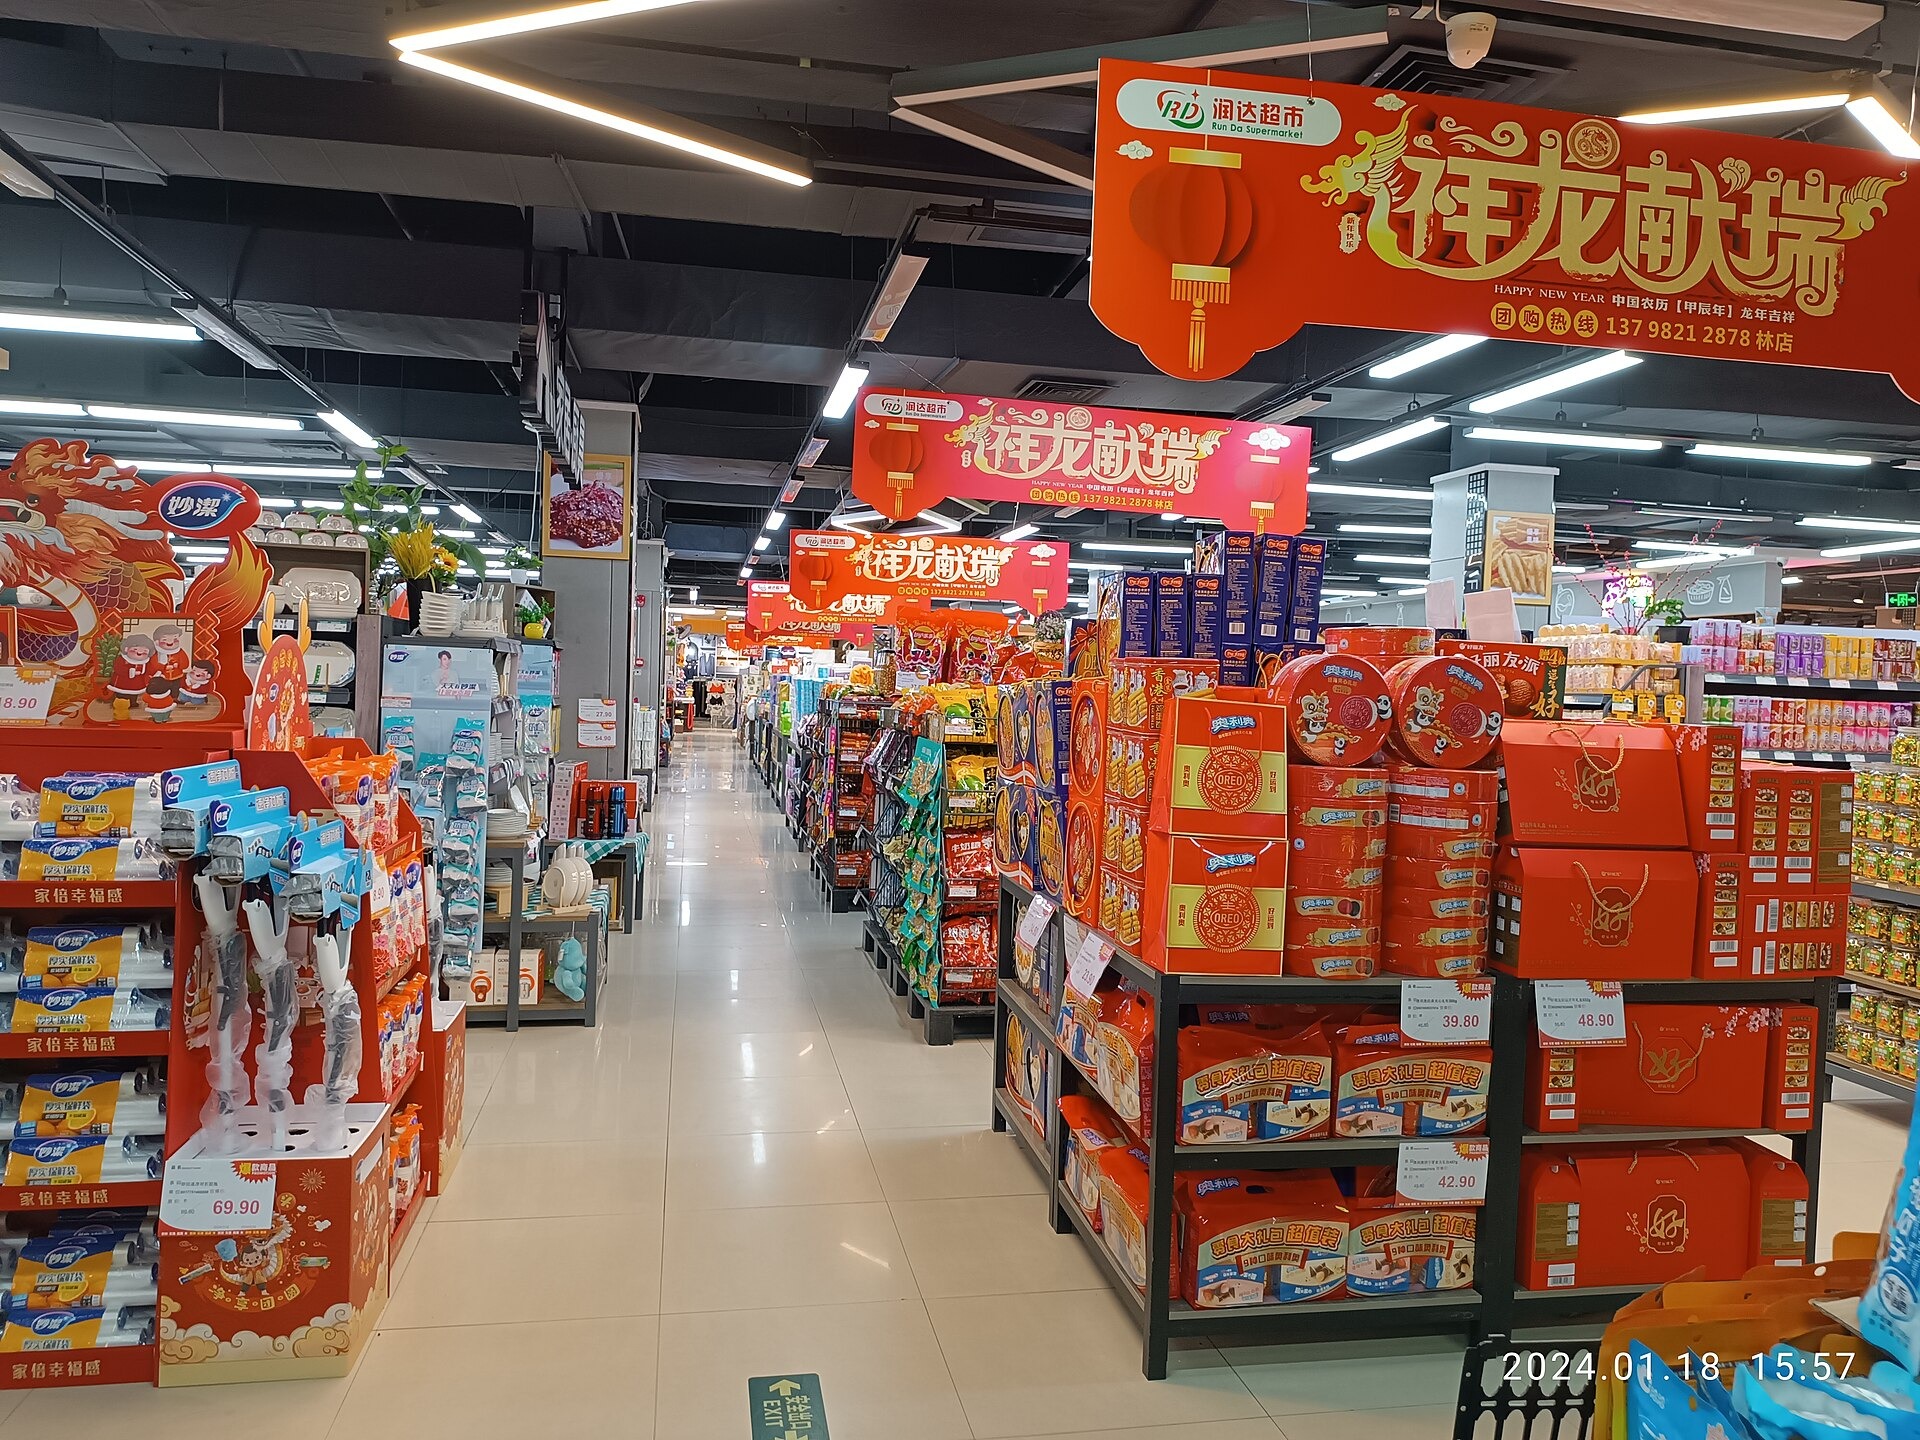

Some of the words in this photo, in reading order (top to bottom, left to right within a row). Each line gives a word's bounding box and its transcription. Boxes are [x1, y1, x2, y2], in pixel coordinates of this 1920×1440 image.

[1212, 97, 1304, 128] 润达超市
[1211, 120, 1228, 131] Run
[1230, 123, 1243, 133] Da
[1246, 125, 1304, 139] Supermarket
[1345, 215, 1355, 249] 新年快乐
[1392, 128, 1846, 318] 祥龙献瑞
[1494, 284, 1535, 297] HAPPY
[1539, 289, 1567, 300] NEW
[1572, 291, 1605, 304] YEAR
[1611, 294, 1668, 312] 中国农历
[1741, 306, 1796, 324] 龙年吉祥
[1494, 305, 1597, 337] 团购热线
[1606, 316, 1642, 337] 137
[1649, 320, 1697, 342] 9821
[1702, 326, 1751, 347] 2878
[1755, 330, 1795, 353] 林店
[905, 401, 947, 414] 润达超市
[990, 414, 1200, 495] 祥龙献瑞
[1083, 493, 1102, 503] 137
[1103, 495, 1127, 506] 9821
[1129, 498, 1153, 508] 2878
[1154, 499, 1174, 510] 林店
[870, 540, 999, 587] 祥龙献瑞
[1150, 668, 1167, 697] 香港
[1212, 716, 1256, 733] 奥利奥
[1217, 775, 1243, 786] OREO
[34, 887, 123, 903] 家倍幸福感
[1214, 913, 1240, 924] OREO
[1442, 1014, 1480, 1028] 39.80
[1578, 1013, 1614, 1027] 48.90
[27, 1036, 116, 1053] 家倍幸福感
[1438, 1175, 1476, 1188] 42.90
[19, 1189, 109, 1206] 家倍幸福感
[213, 1200, 260, 1215] 69.90
[12, 1360, 101, 1380] 家倍幸福感
[763, 1399, 784, 1428] EXIT
[785, 1394, 813, 1429] 安全出口
